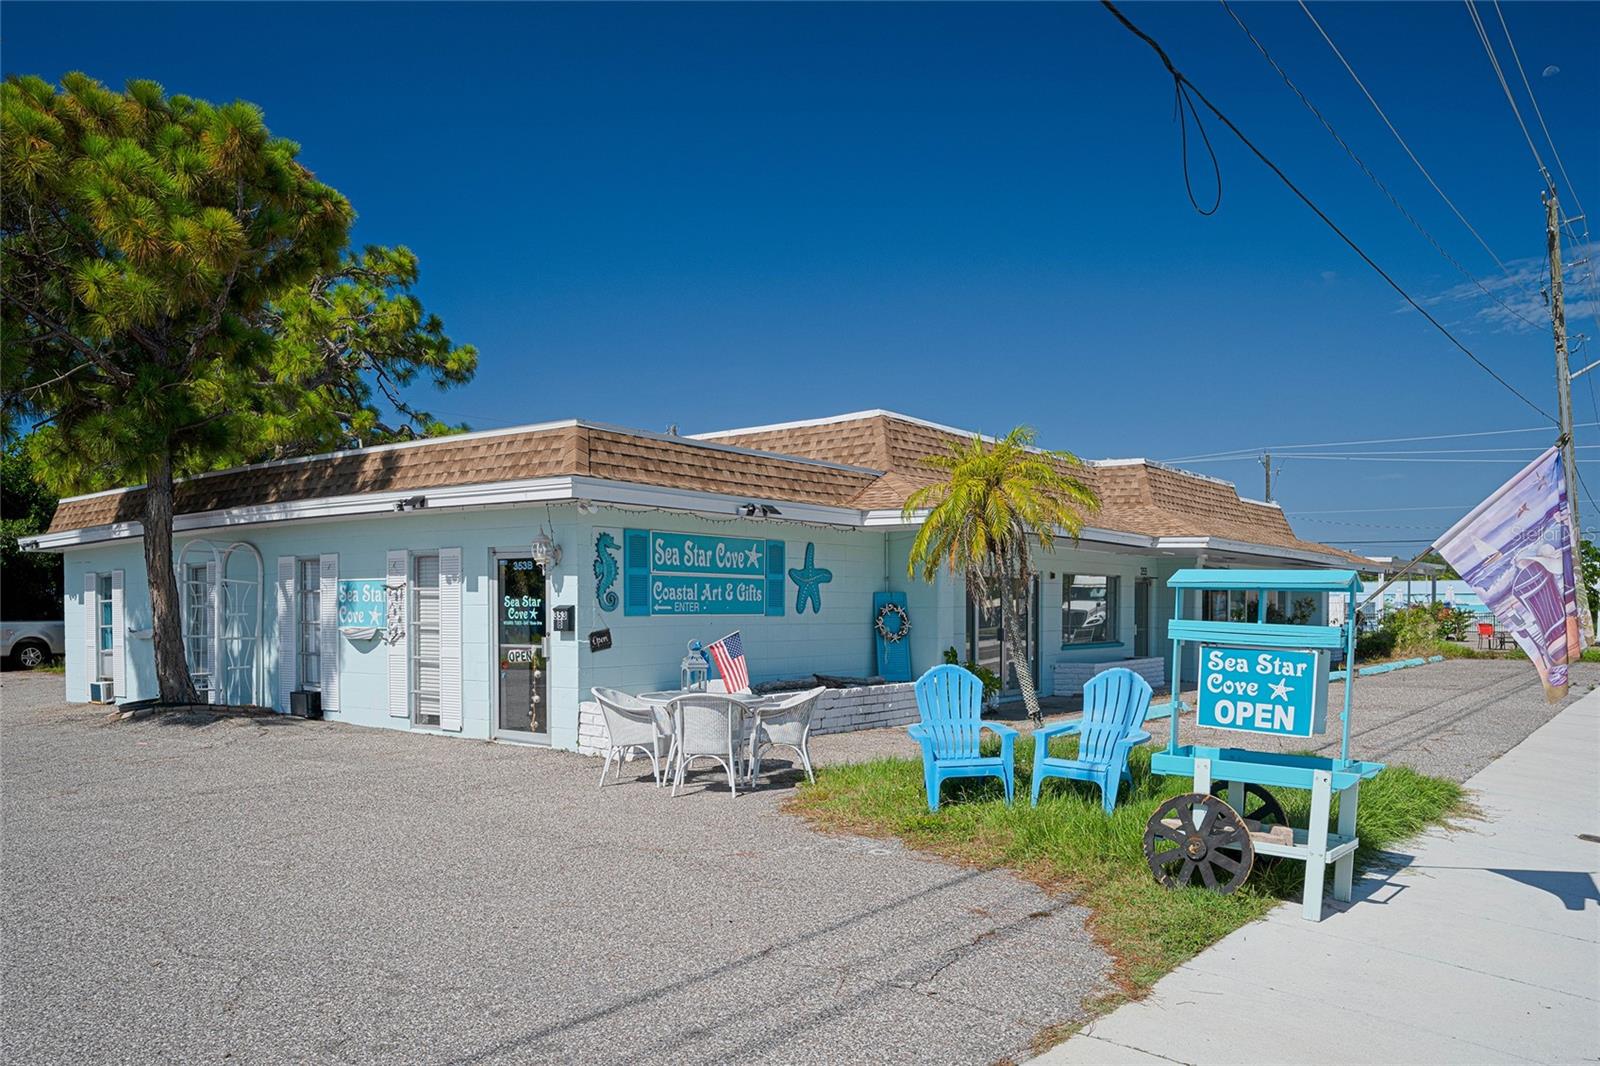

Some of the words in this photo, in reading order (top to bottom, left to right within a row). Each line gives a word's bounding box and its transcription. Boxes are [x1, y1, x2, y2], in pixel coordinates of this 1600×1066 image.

[655, 538, 680, 565] Sea
[684, 540, 712, 567] Star
[716, 542, 744, 568] Cove
[513, 561, 533, 570] 353B
[339, 584, 359, 602] Sea
[653, 581, 698, 600] Coastal
[701, 583, 722, 601] Art
[725, 583, 733, 601] &
[736, 582, 762, 601] Gifts
[504, 595, 520, 607] Sea
[522, 595, 541, 607] Star
[674, 602, 699, 612] ENTER
[339, 606, 364, 623] Cove
[508, 607, 528, 619] Cove
[592, 635, 609, 646] Open
[508, 651, 532, 663] OPEN
[1208, 650, 1249, 673] Sea
[1256, 653, 1308, 677] Star
[1207, 673, 1258, 697] Cove
[1214, 699, 1295, 731] OPEN
